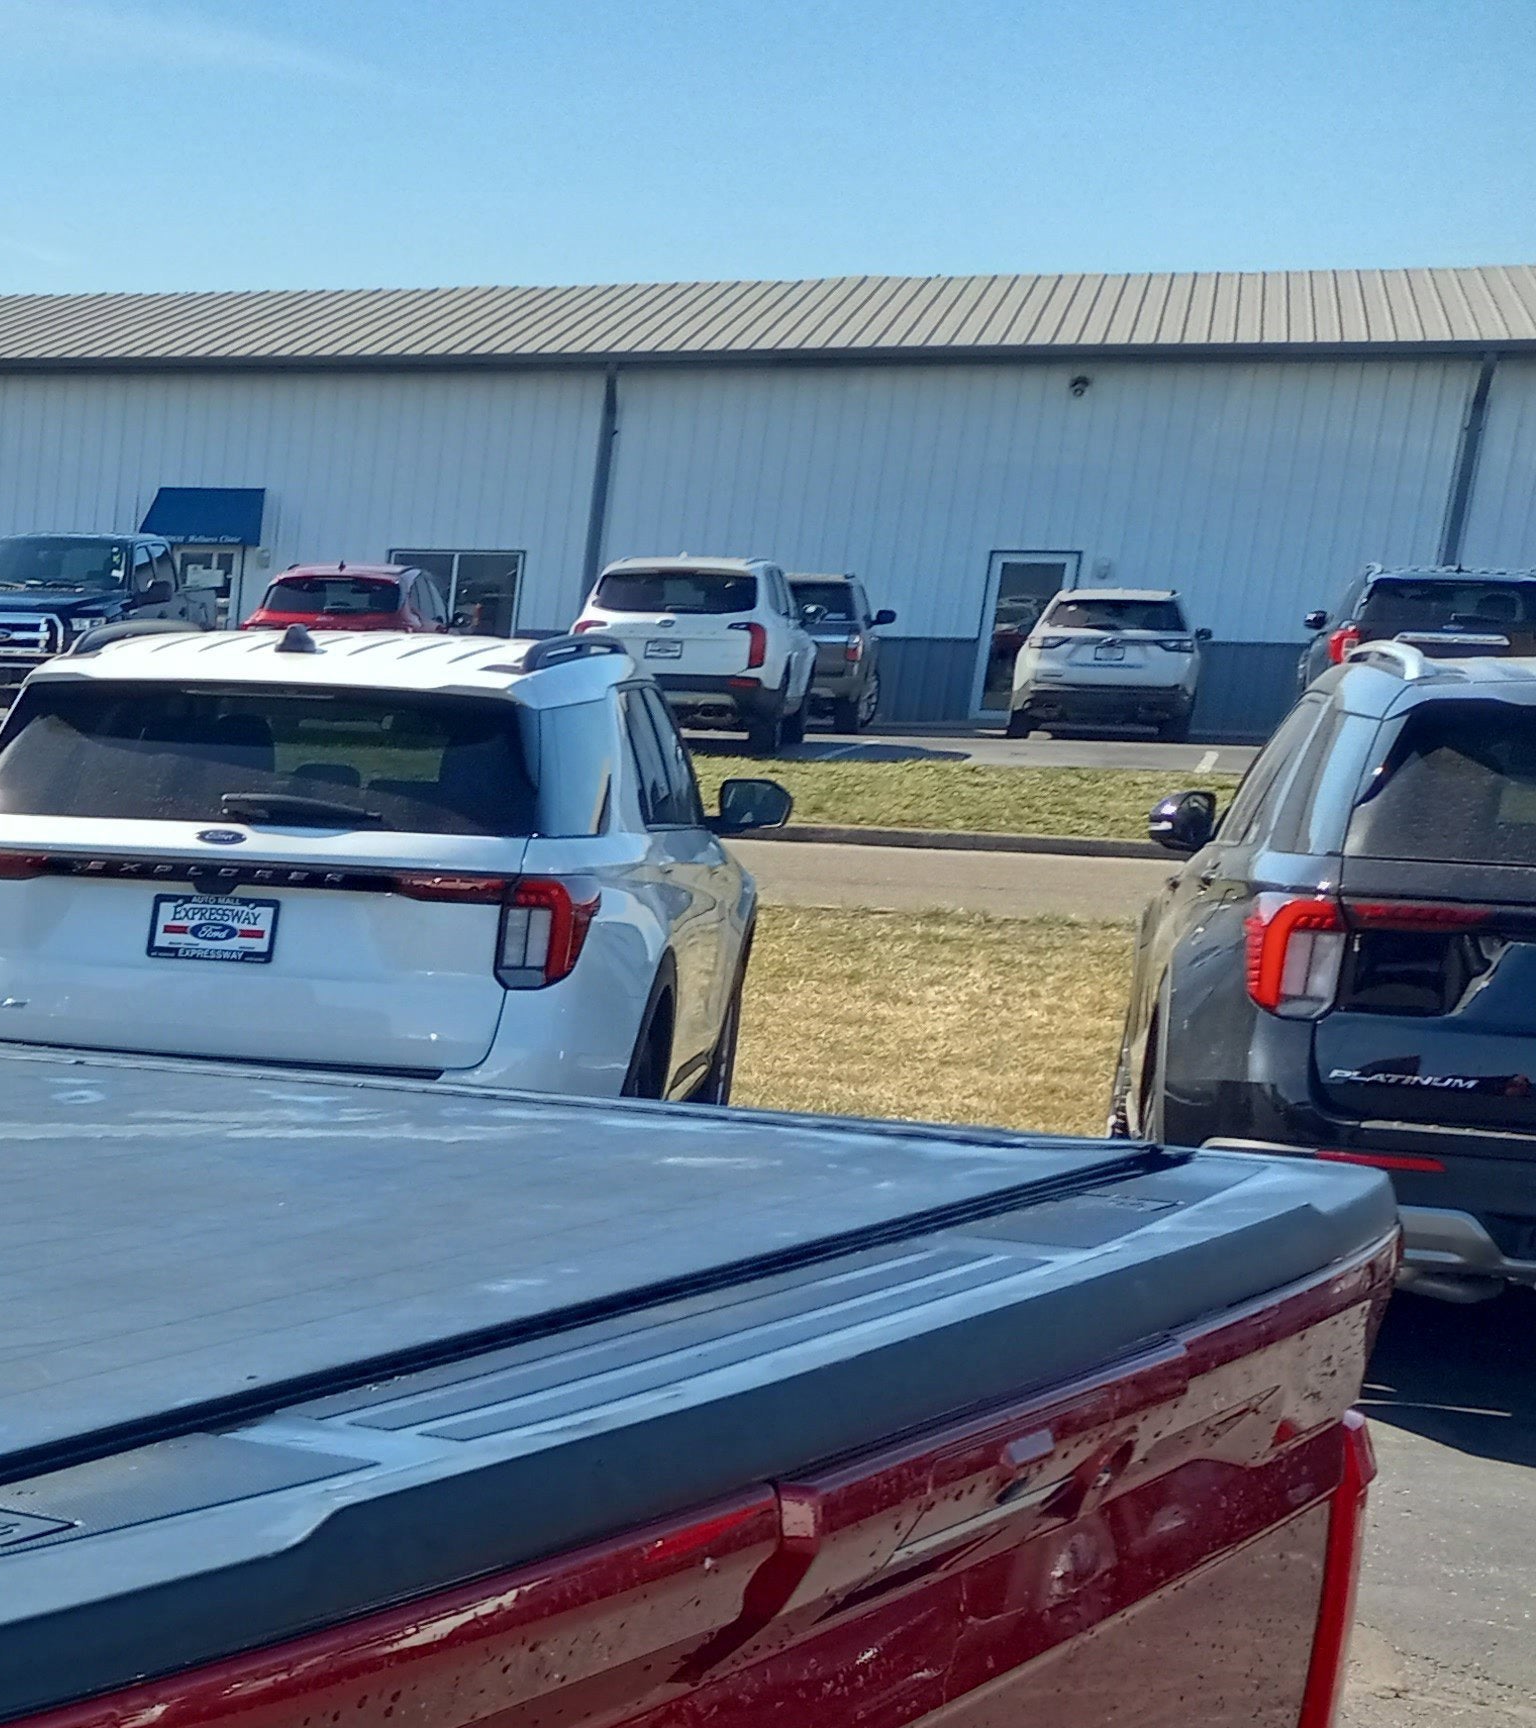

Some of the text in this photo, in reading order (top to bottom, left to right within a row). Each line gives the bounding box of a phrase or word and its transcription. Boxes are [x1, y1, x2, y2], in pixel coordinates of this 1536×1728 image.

[85, 861, 345, 882] EXPLORER
[191, 896, 216, 904] AUTO
[171, 905, 261, 925] EXPRESSWAY
[197, 925, 231, 939] Ford
[178, 948, 244, 960] EXPRESSWAY
[1329, 1069, 1479, 1089] PLATINUM
